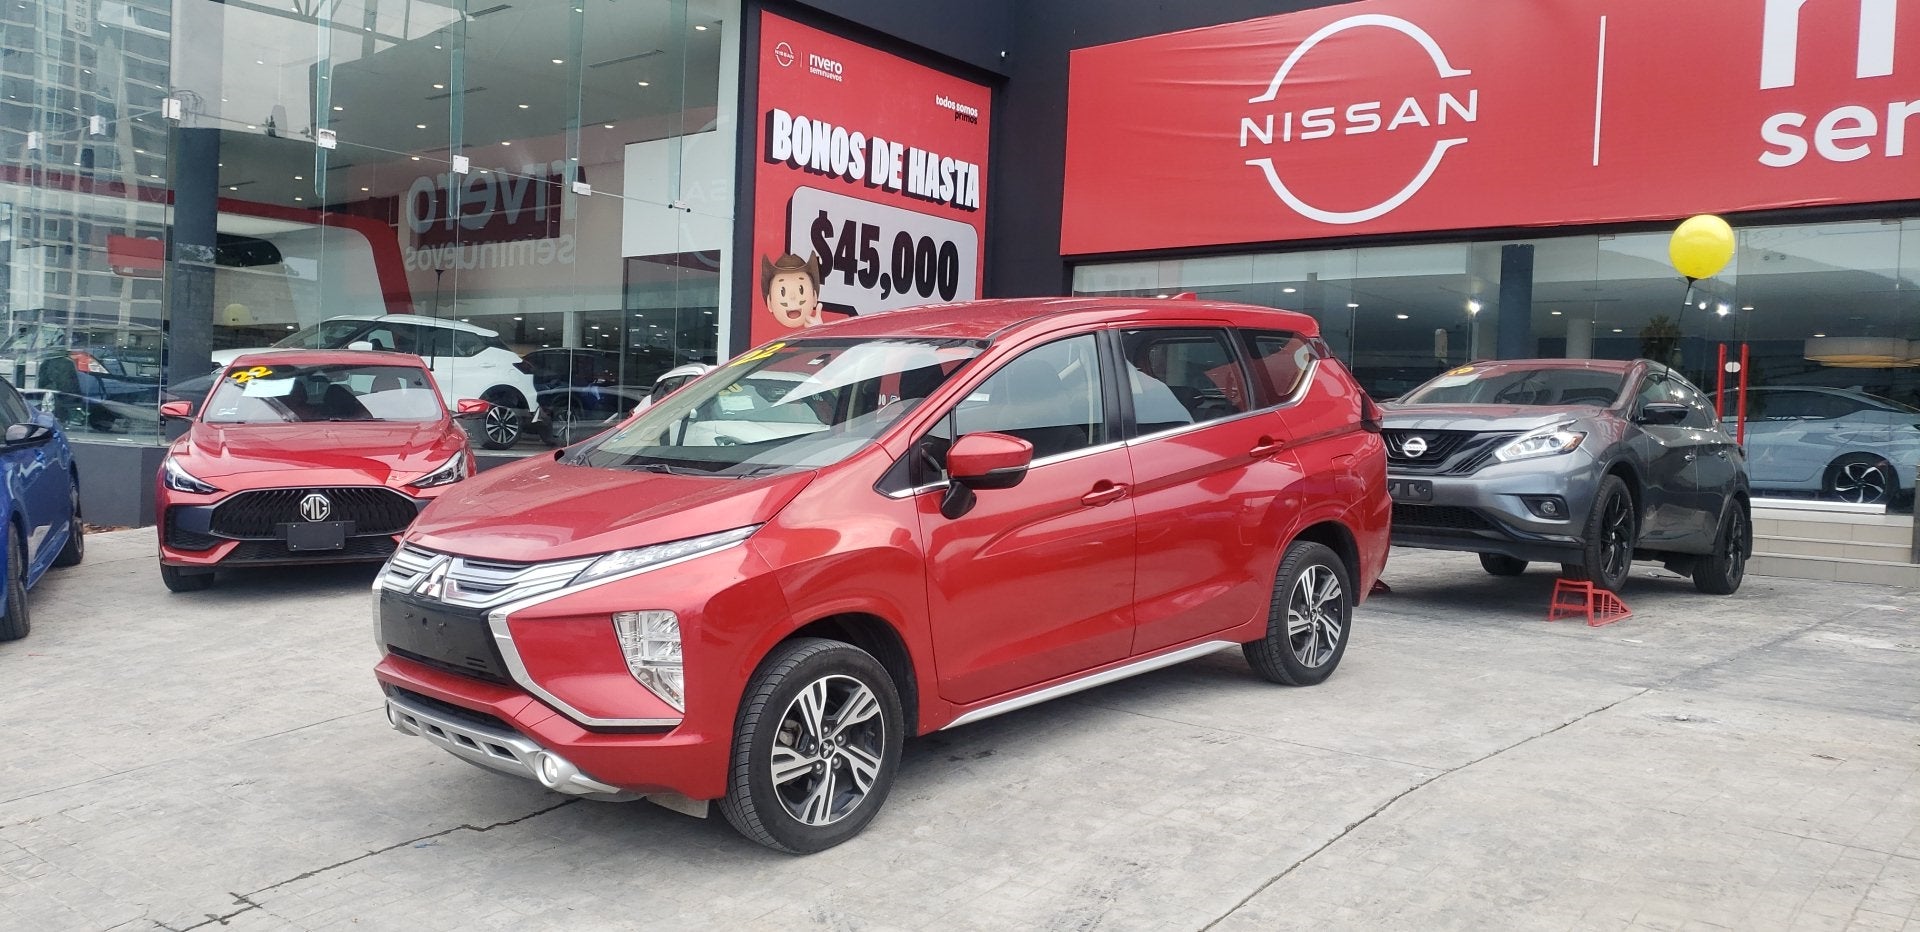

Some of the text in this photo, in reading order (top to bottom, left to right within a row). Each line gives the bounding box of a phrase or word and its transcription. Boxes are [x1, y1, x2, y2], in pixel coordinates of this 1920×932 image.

[809, 53, 842, 75] rivero
[809, 66, 842, 82] seminuevos
[935, 94, 978, 118] todos somos
[955, 111, 978, 125] primos
[1240, 89, 1478, 147] NISSAN
[772, 108, 980, 209] BONOS DE HASTA
[810, 209, 959, 302] $45,000
[231, 366, 273, 384] 22
[303, 497, 327, 520] MG
